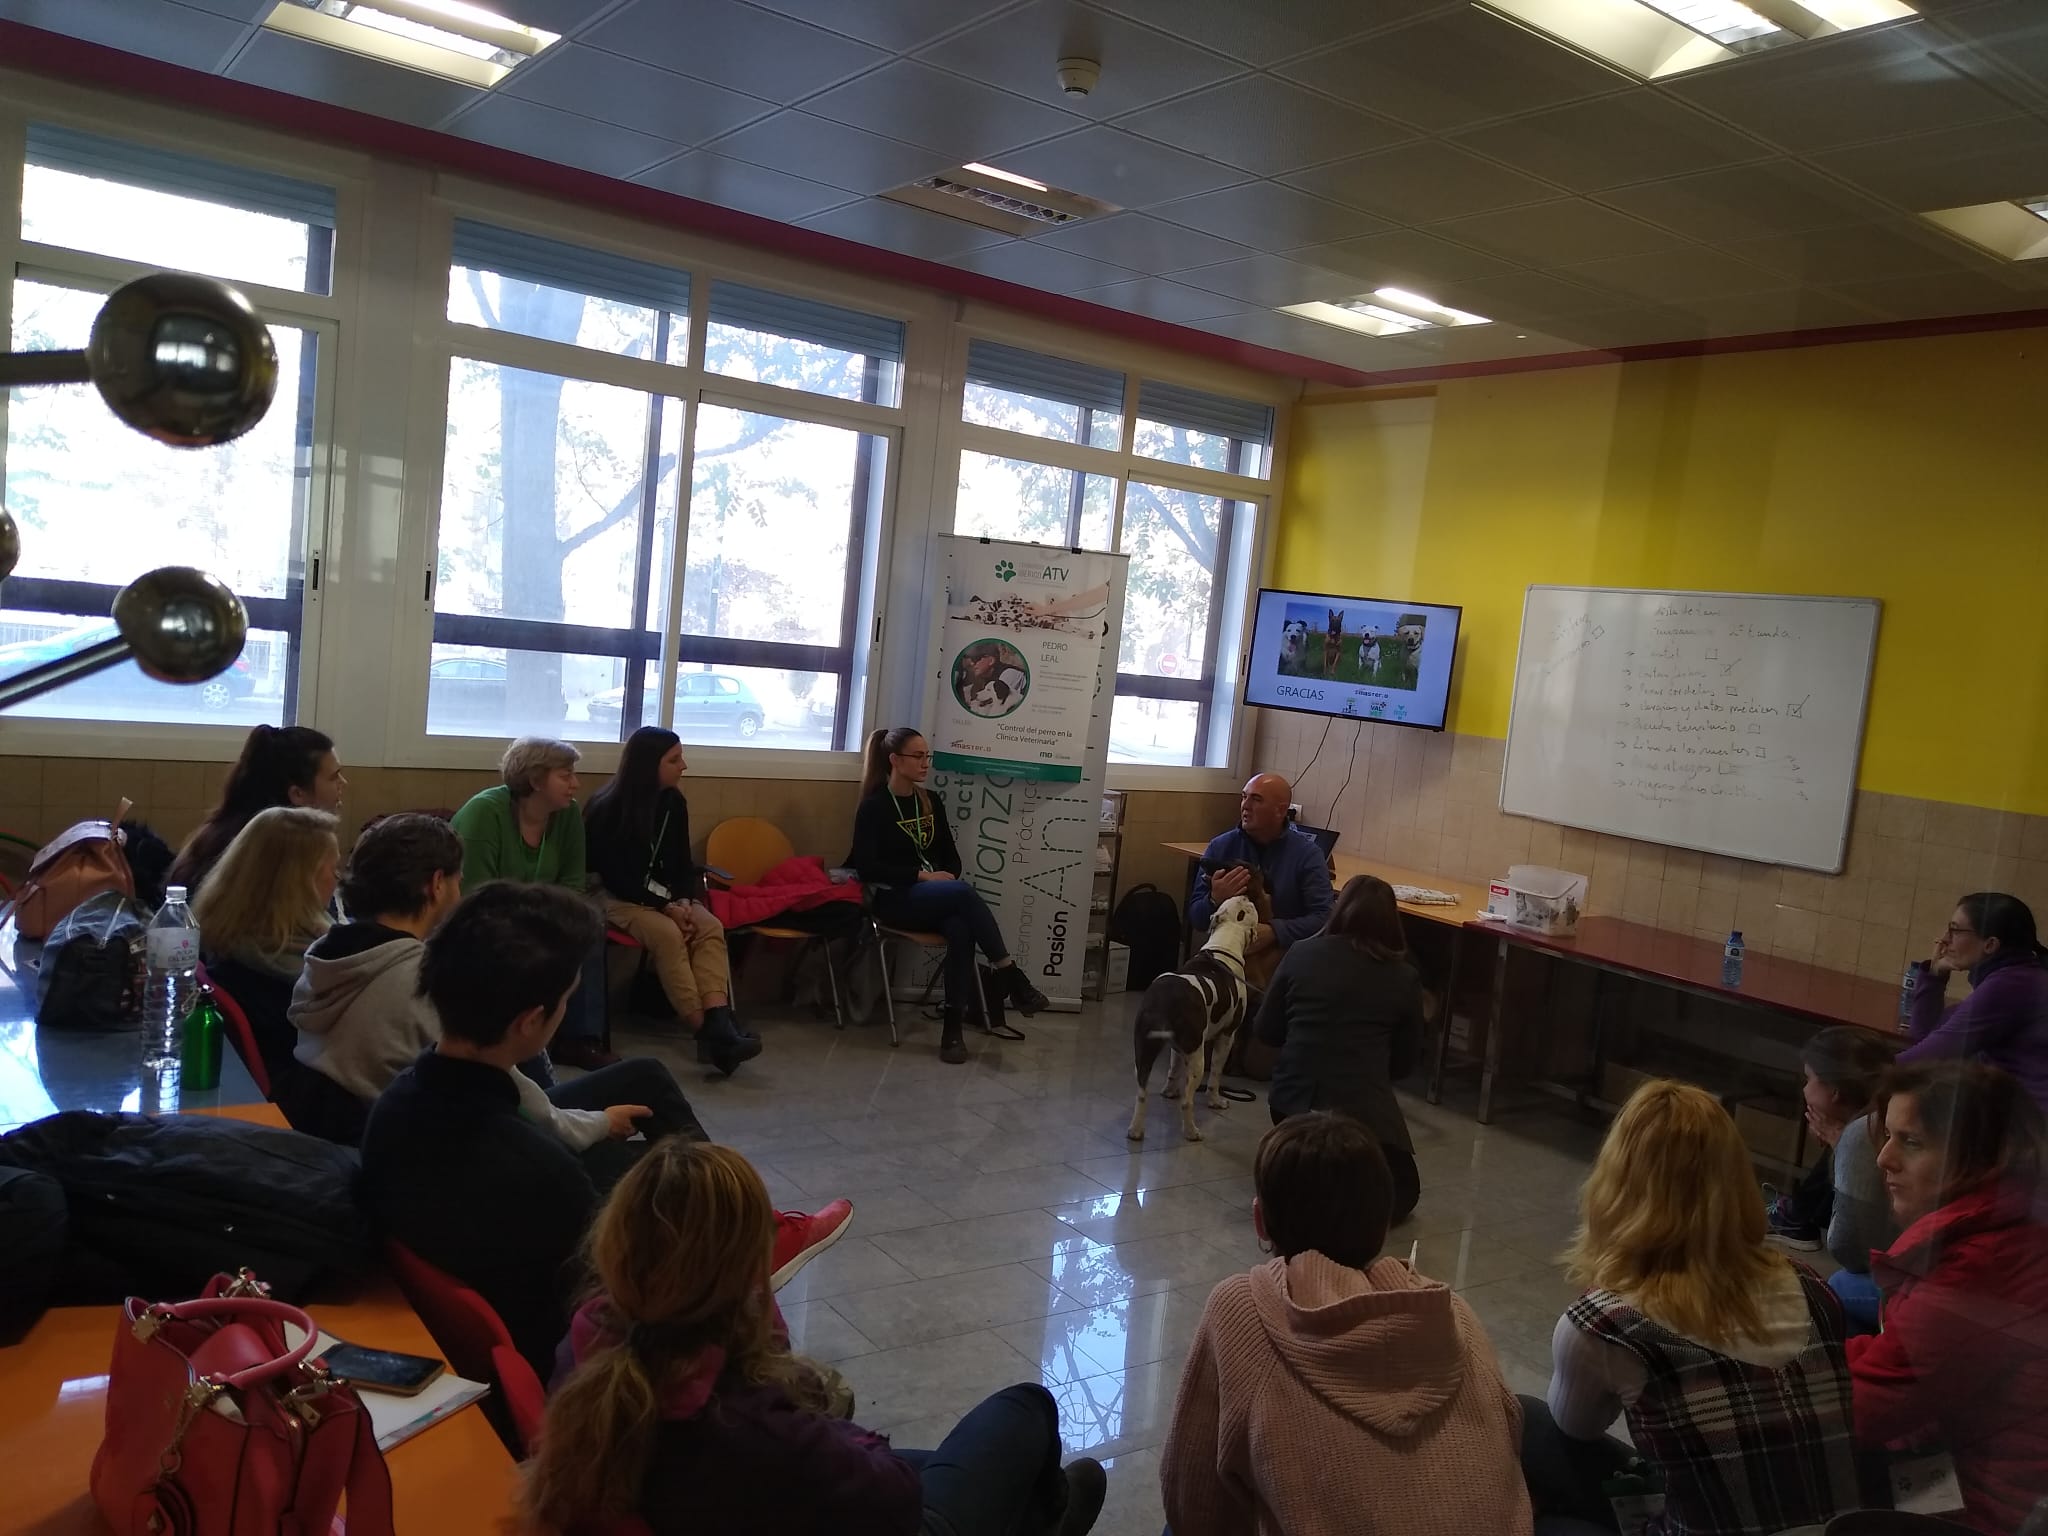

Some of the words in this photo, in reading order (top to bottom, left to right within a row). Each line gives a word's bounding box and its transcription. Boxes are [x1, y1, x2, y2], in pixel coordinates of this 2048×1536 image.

[1042, 566, 1069, 581] ATV
[1042, 641, 1068, 651] PEDRO
[1041, 654, 1059, 663] LEAL
[1276, 685, 1325, 701] GRACIAS
[1026, 726, 1037, 734] del
[1038, 729, 1056, 737] perro
[1066, 730, 1073, 738] la
[1012, 894, 1036, 971] eterinaria
[1043, 910, 1069, 977] Pasión
